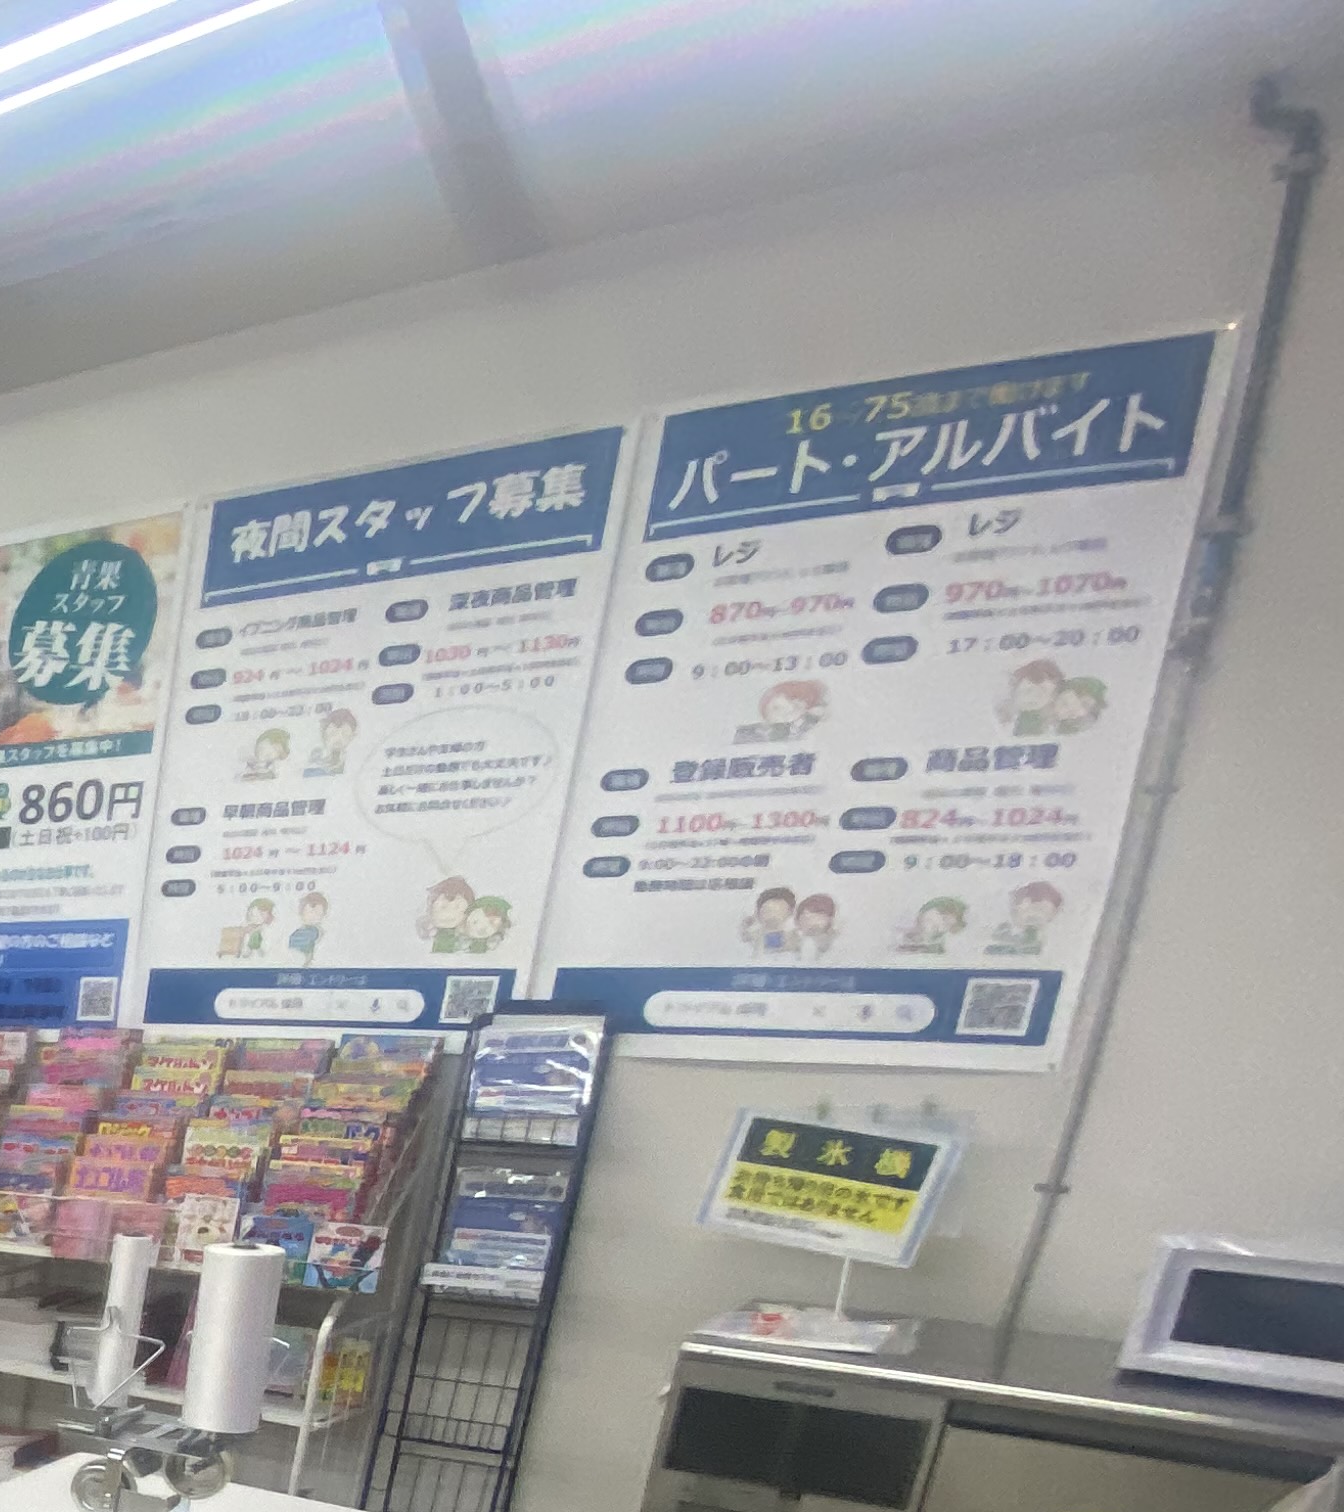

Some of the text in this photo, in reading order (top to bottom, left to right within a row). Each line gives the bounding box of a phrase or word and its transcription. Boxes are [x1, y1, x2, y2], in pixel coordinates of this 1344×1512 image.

[668, 392, 1166, 512] パート・アルバイト
[229, 462, 587, 564] 夜間スタッフ募集
[968, 508, 1023, 537] レジ
[712, 539, 763, 568] レジ
[69, 559, 124, 591] 青果
[50, 592, 128, 616] スタッフ
[11, 619, 137, 692] 募集
[18, 778, 146, 825] 860円
